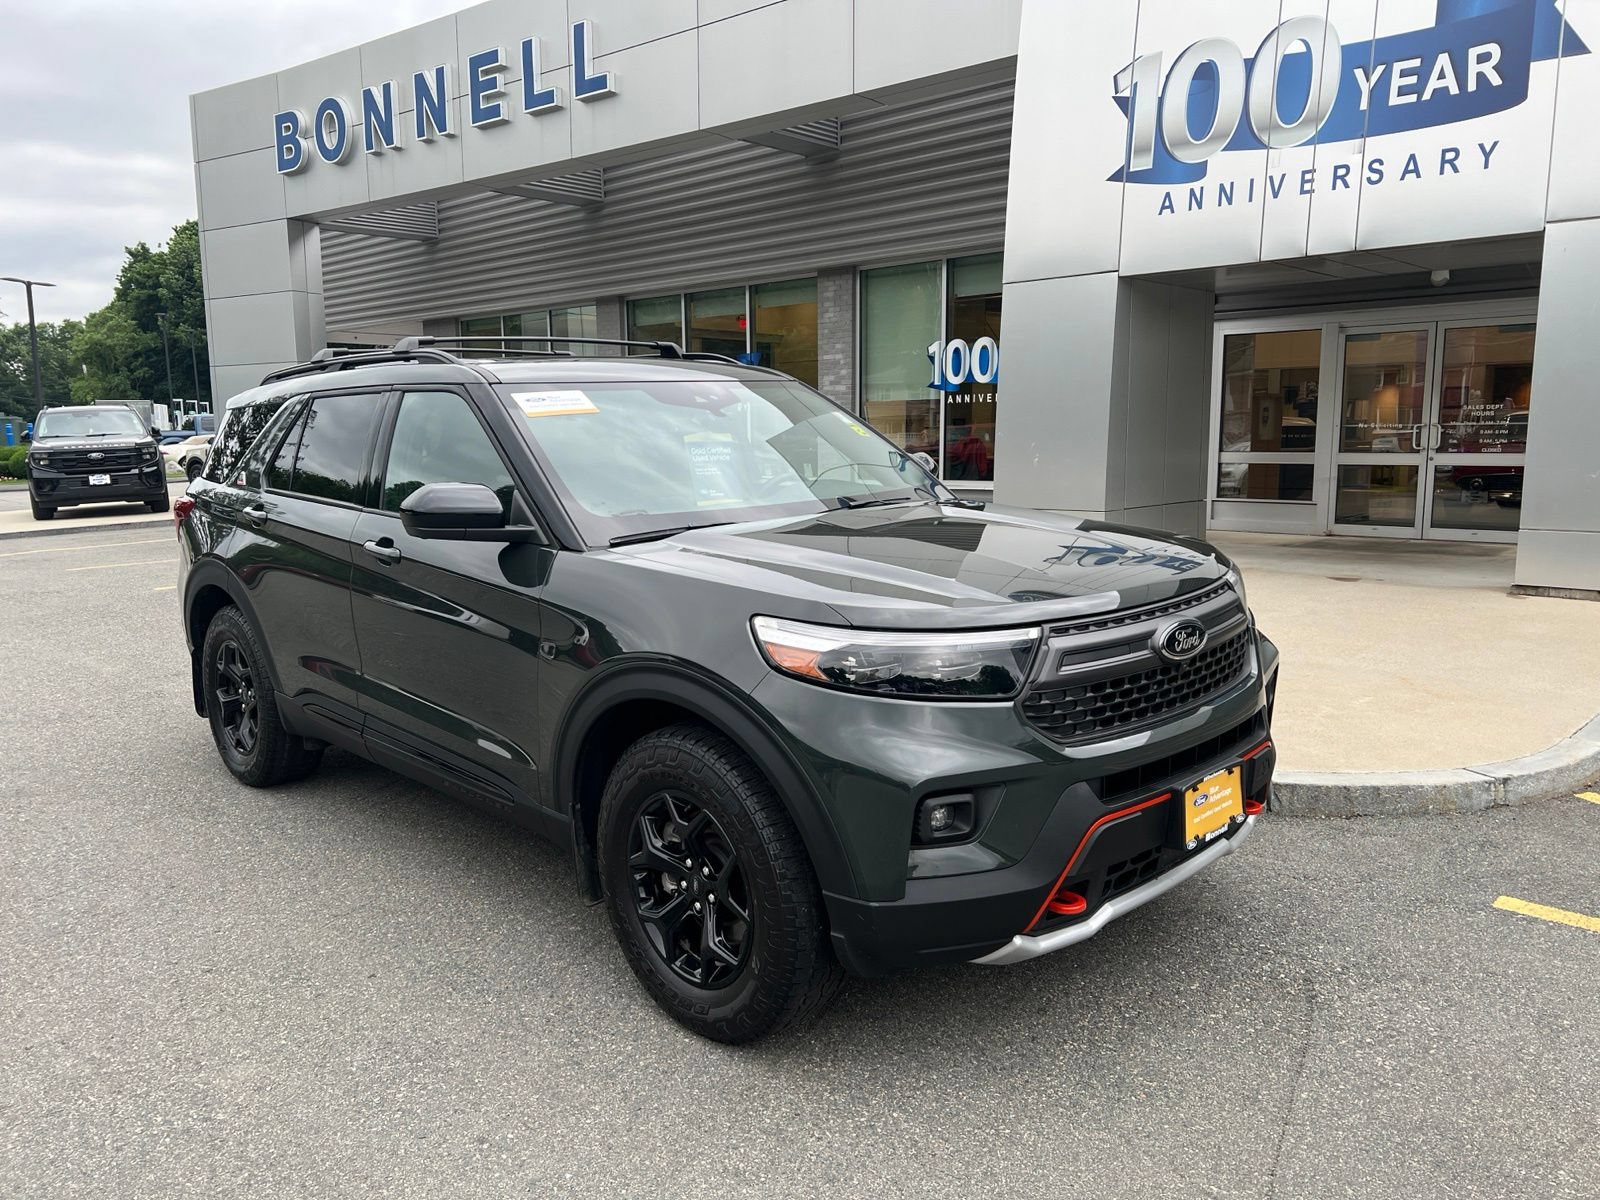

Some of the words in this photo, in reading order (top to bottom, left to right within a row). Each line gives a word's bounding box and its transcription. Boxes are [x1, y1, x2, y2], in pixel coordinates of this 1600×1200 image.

[274, 20, 615, 175] BONNELL
[1113, 15, 1342, 171] 100
[1353, 42, 1502, 111] YEAR
[1158, 140, 1500, 215] ANNIVERSARY
[928, 336, 999, 385] 100
[947, 393, 998, 404] ANNIVE
[1174, 629, 1201, 652] Ford
